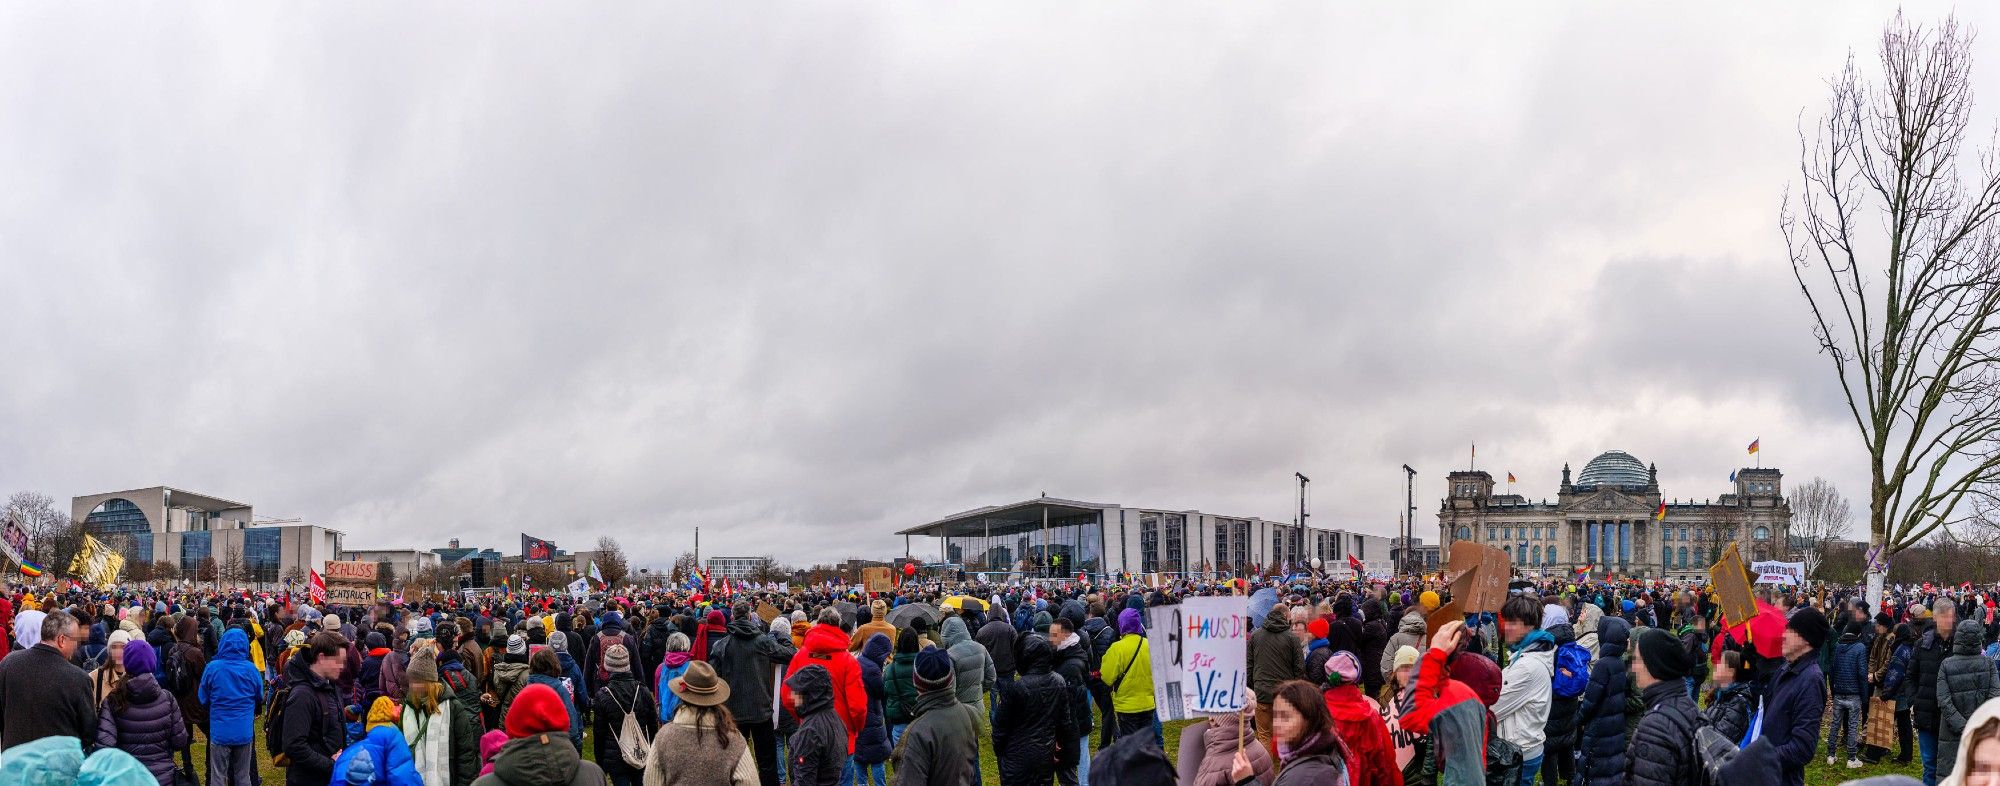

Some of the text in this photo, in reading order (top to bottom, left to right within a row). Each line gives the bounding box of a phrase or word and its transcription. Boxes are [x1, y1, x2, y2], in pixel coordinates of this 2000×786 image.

[328, 562, 373, 578] SCHLUSS
[326, 589, 372, 601] RECHTSRUCK
[1187, 614, 1230, 639] HAUS
[1187, 652, 1216, 672] für
